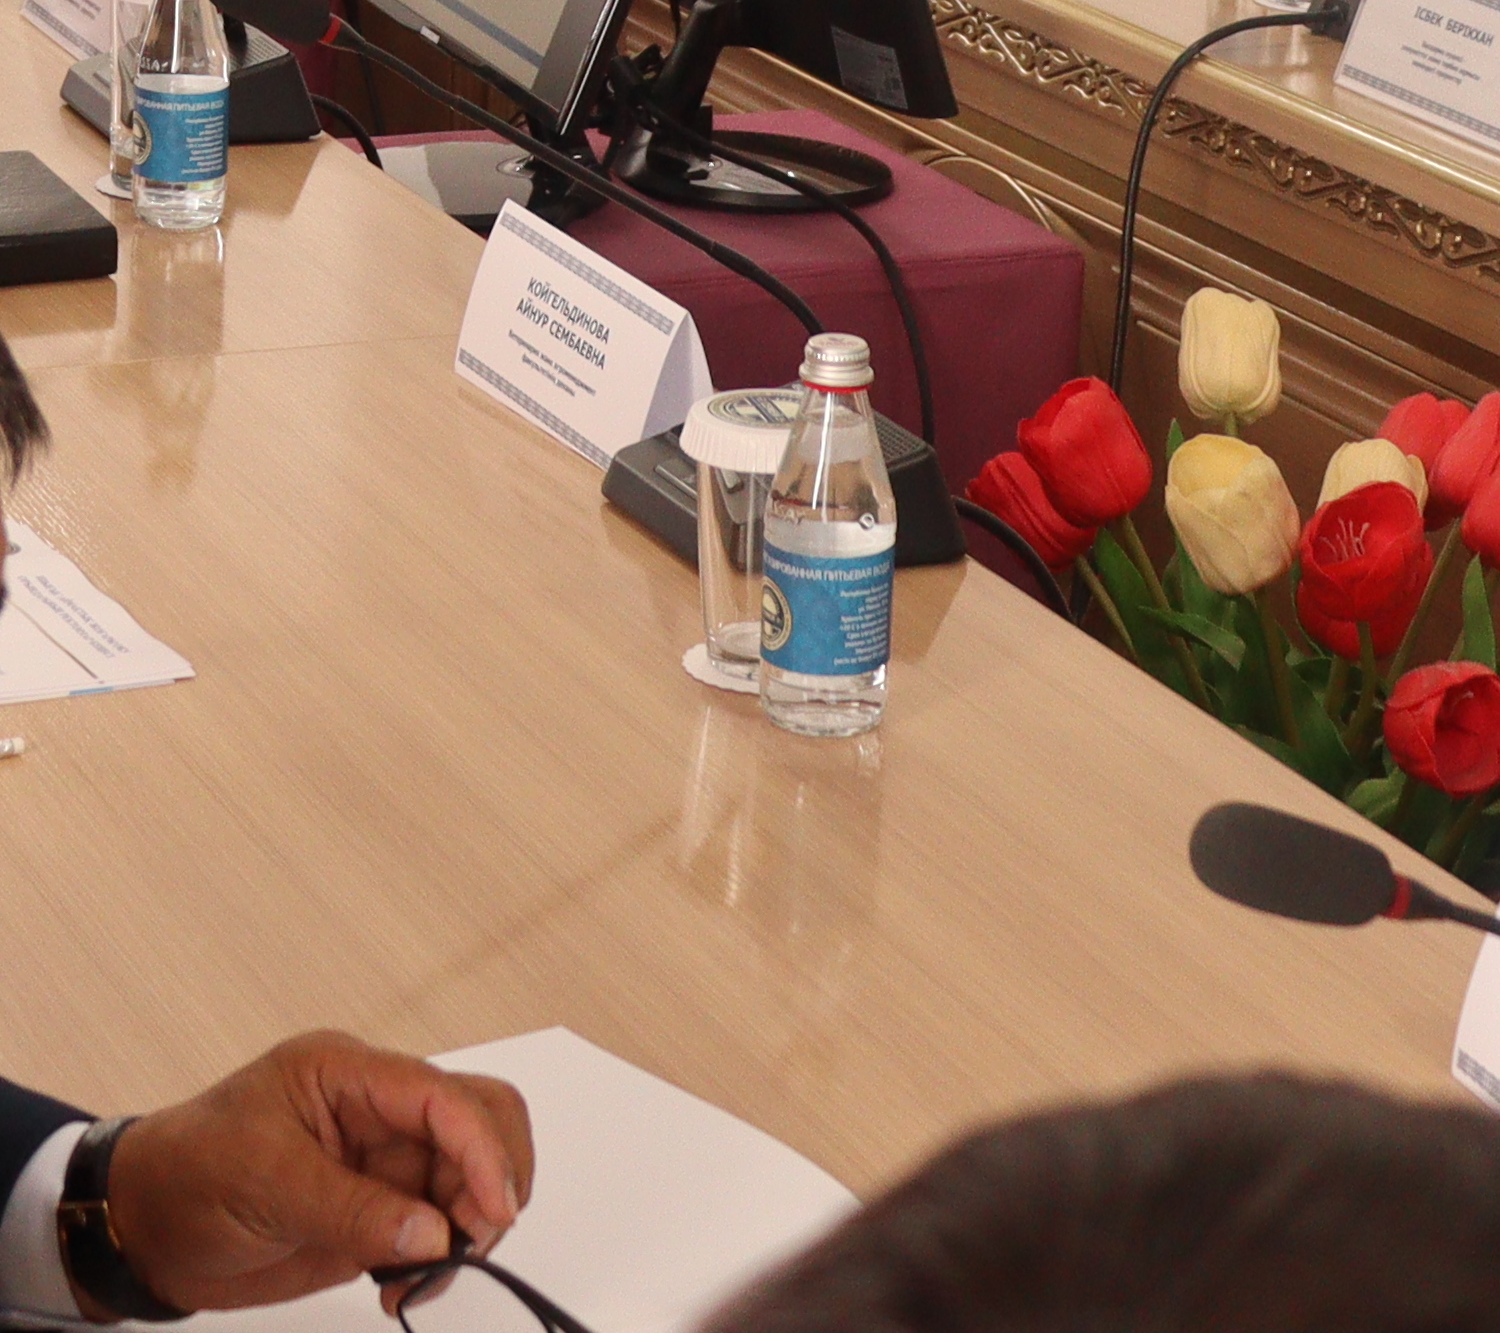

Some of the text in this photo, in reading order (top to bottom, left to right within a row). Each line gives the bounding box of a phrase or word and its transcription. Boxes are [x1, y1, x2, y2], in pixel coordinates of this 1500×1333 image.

[516, 295, 607, 370] АЙНУР СЕМБАЕВНА
[526, 274, 611, 345] КОЙГЕЛЬДИНОВА
